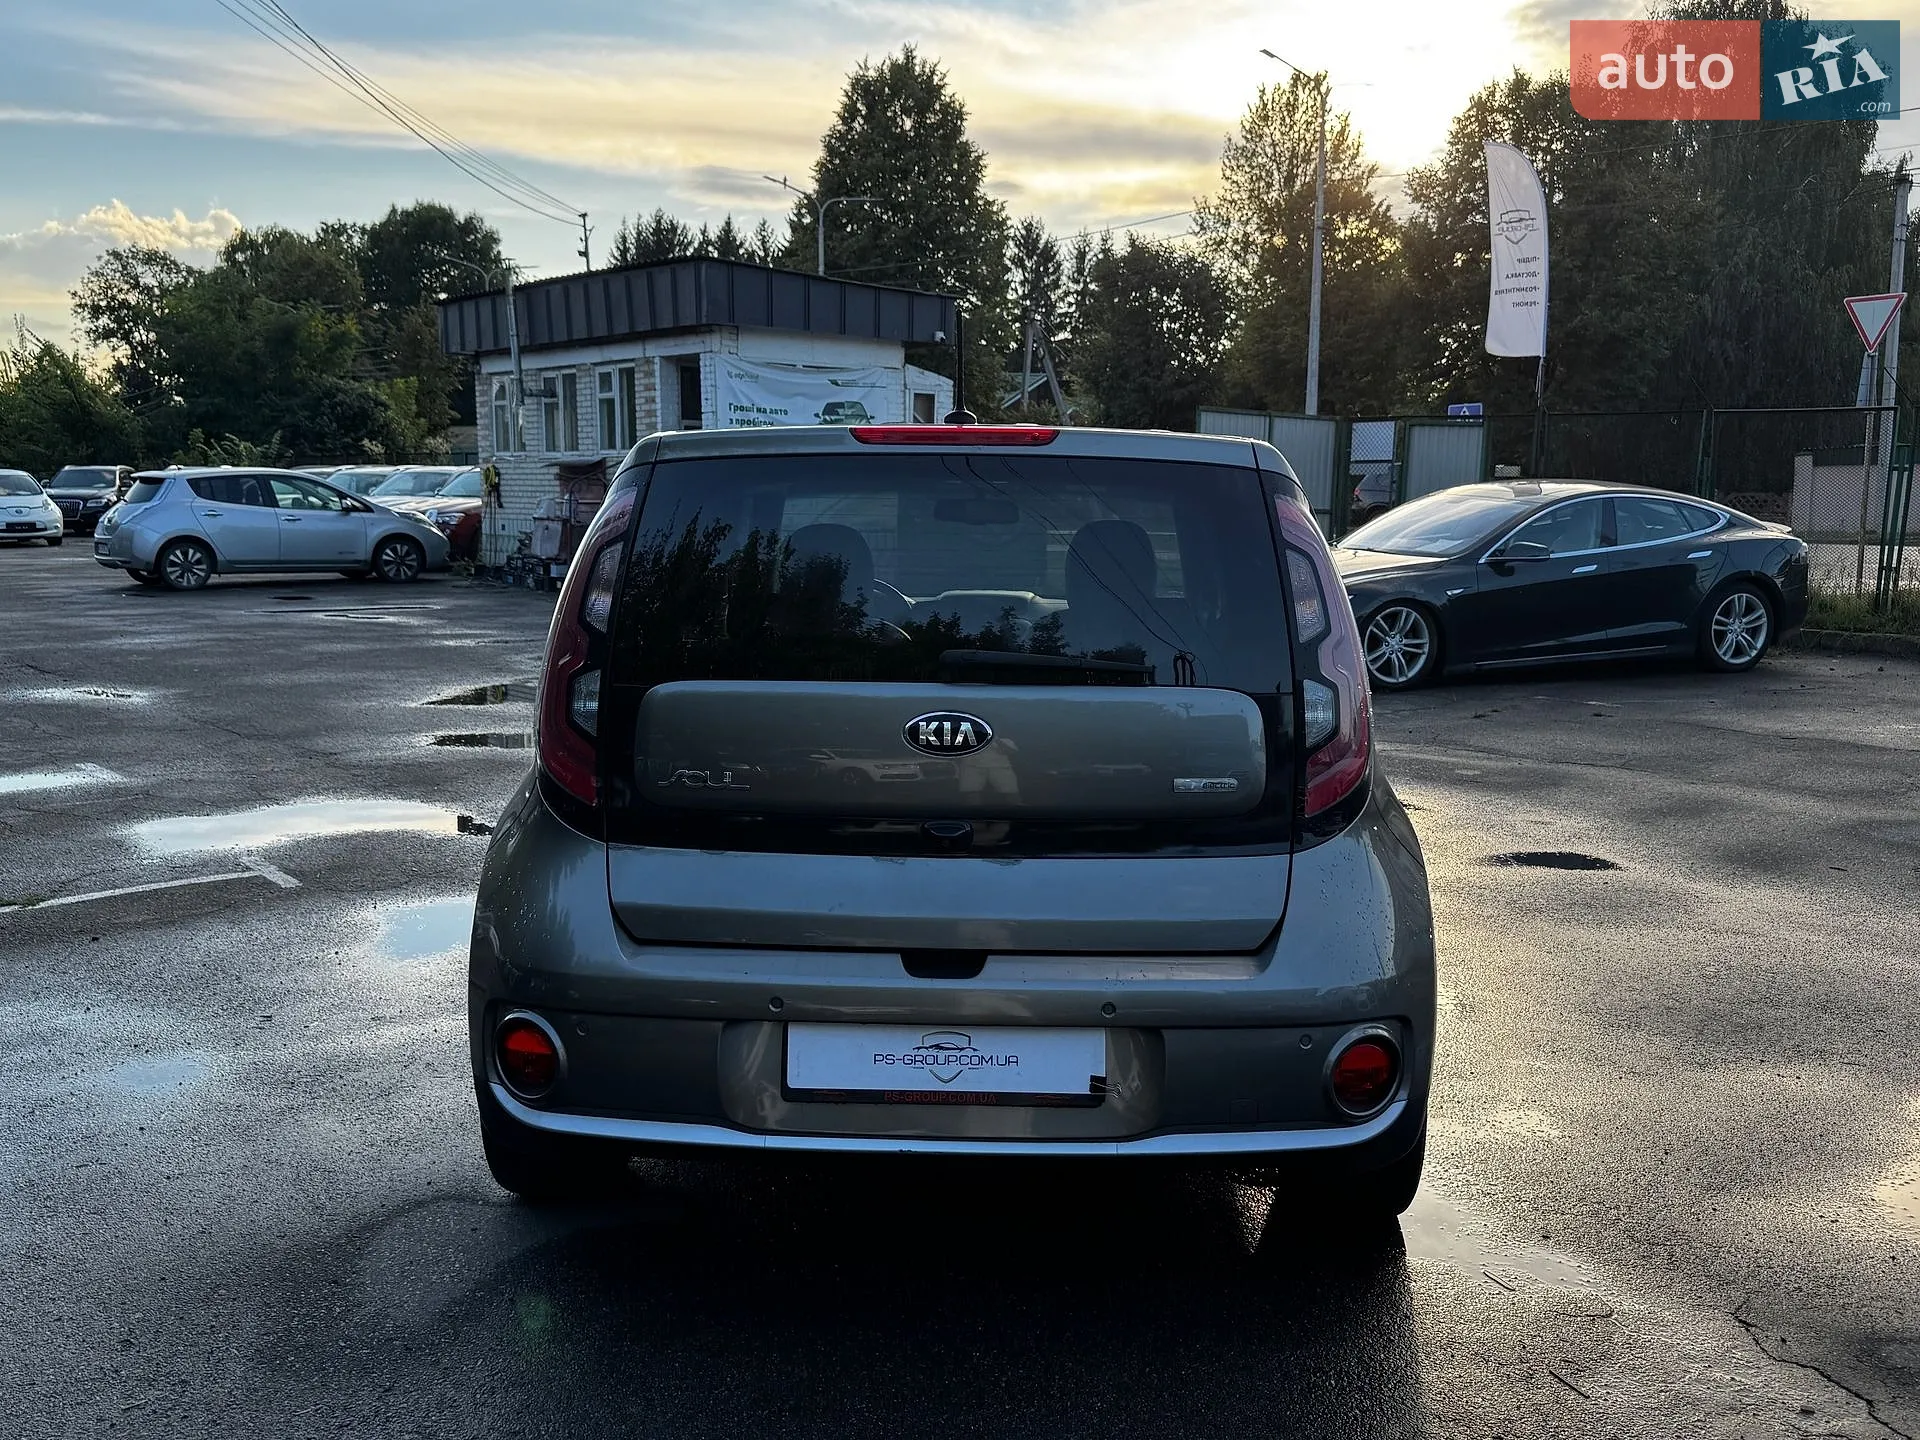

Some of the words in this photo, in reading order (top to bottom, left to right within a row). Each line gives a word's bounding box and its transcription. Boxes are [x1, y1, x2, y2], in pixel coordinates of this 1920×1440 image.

[728, 402, 755, 414] Гроші
[756, 406, 768, 415] на
[768, 408, 789, 416] авто
[918, 721, 978, 746] KIA
[873, 1053, 1019, 1067] PS-GROUP.COM.UA
[884, 1091, 998, 1105] PS-GROUP.COM.UA
